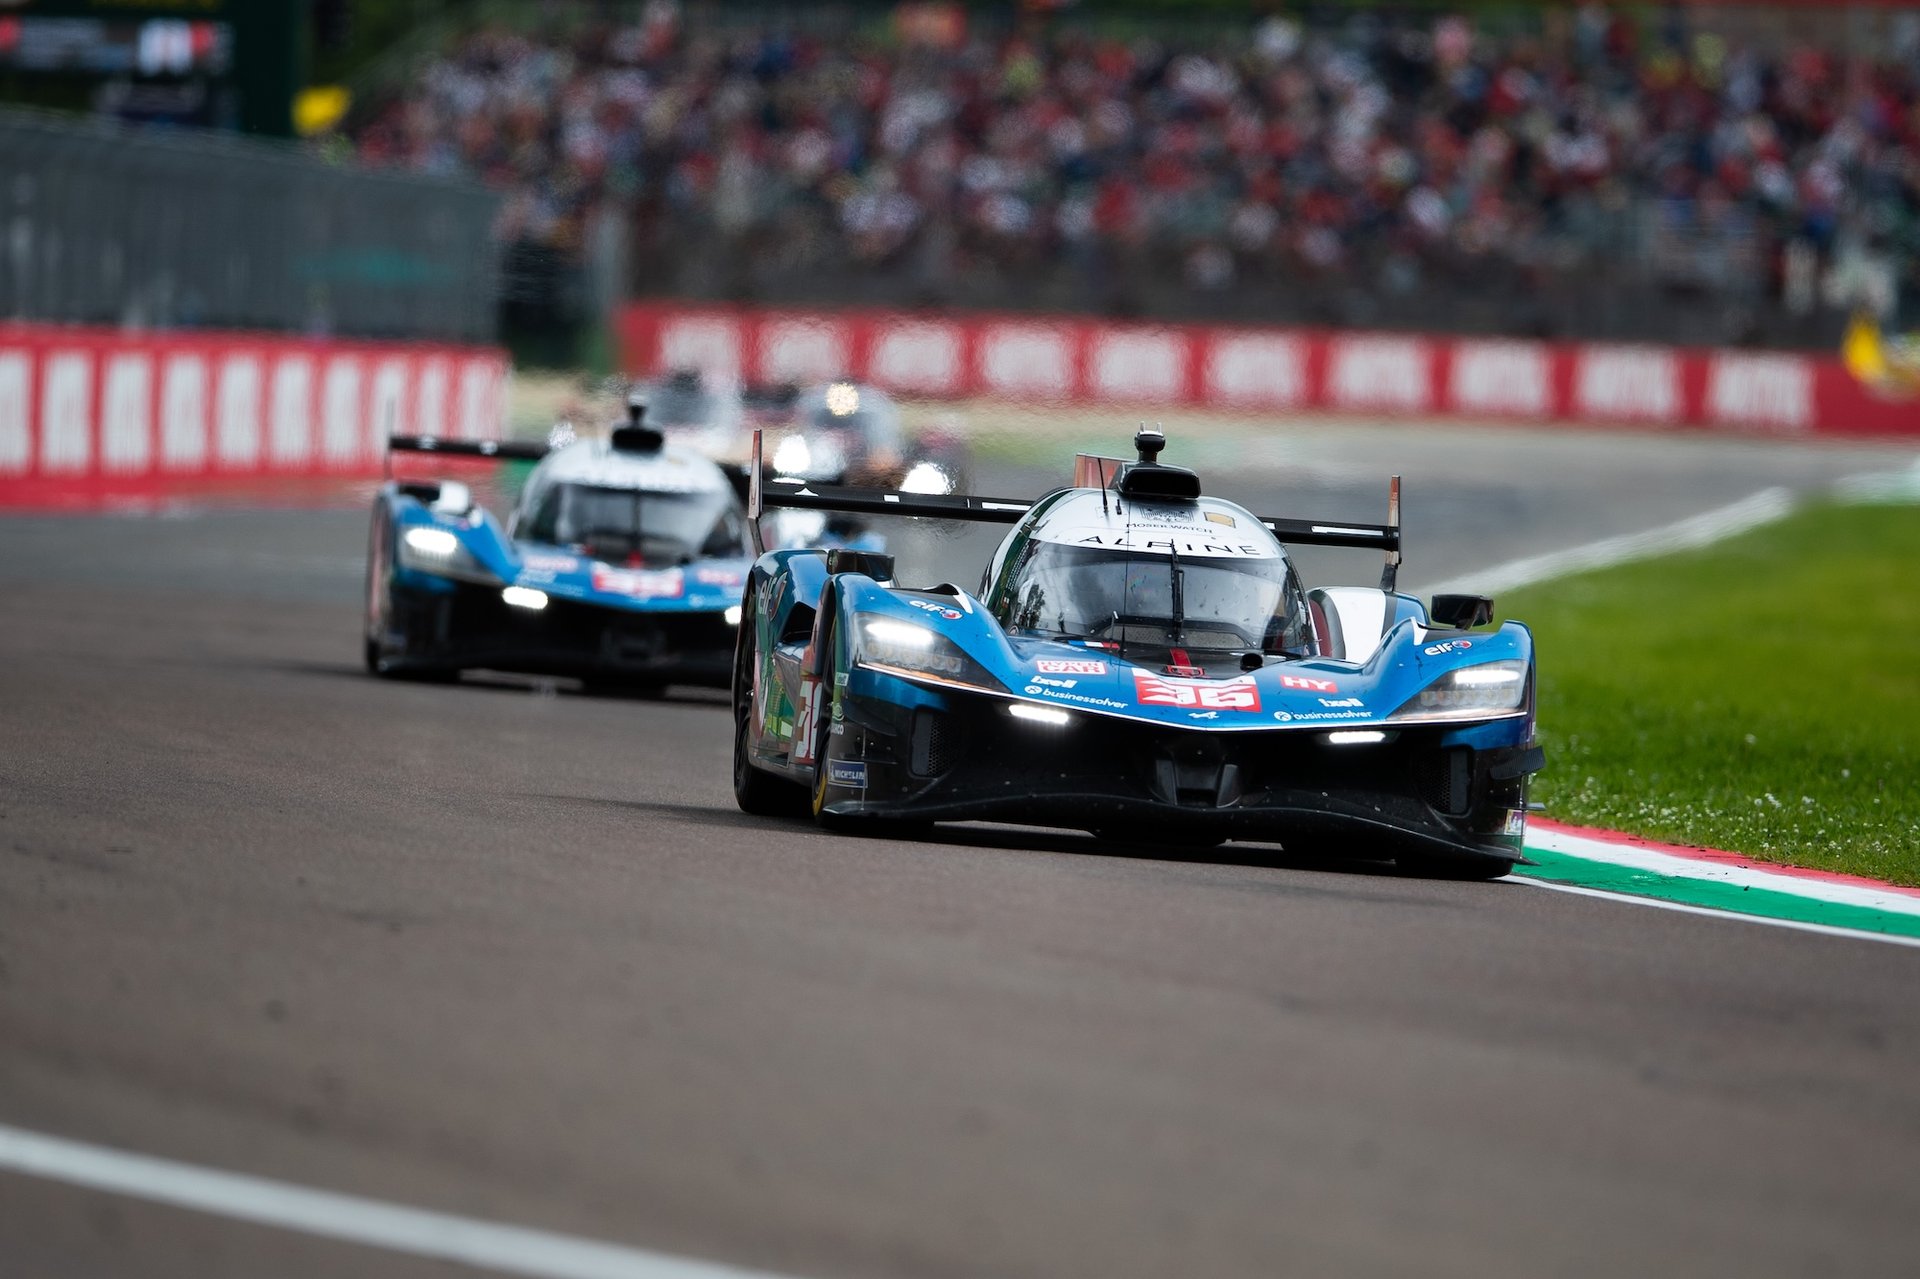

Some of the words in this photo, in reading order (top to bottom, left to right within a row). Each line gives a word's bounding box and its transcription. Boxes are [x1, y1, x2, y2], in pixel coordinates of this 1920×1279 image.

[1078, 535, 1261, 556] ALPINE
[757, 576, 778, 615] elf
[909, 600, 945, 612] elf
[1424, 643, 1453, 656] elf
[1042, 665, 1101, 673] CAR
[1283, 676, 1332, 690] HY
[1042, 688, 1129, 709] businessolver
[1140, 680, 1255, 708] 36
[1291, 710, 1372, 720] businessolver
